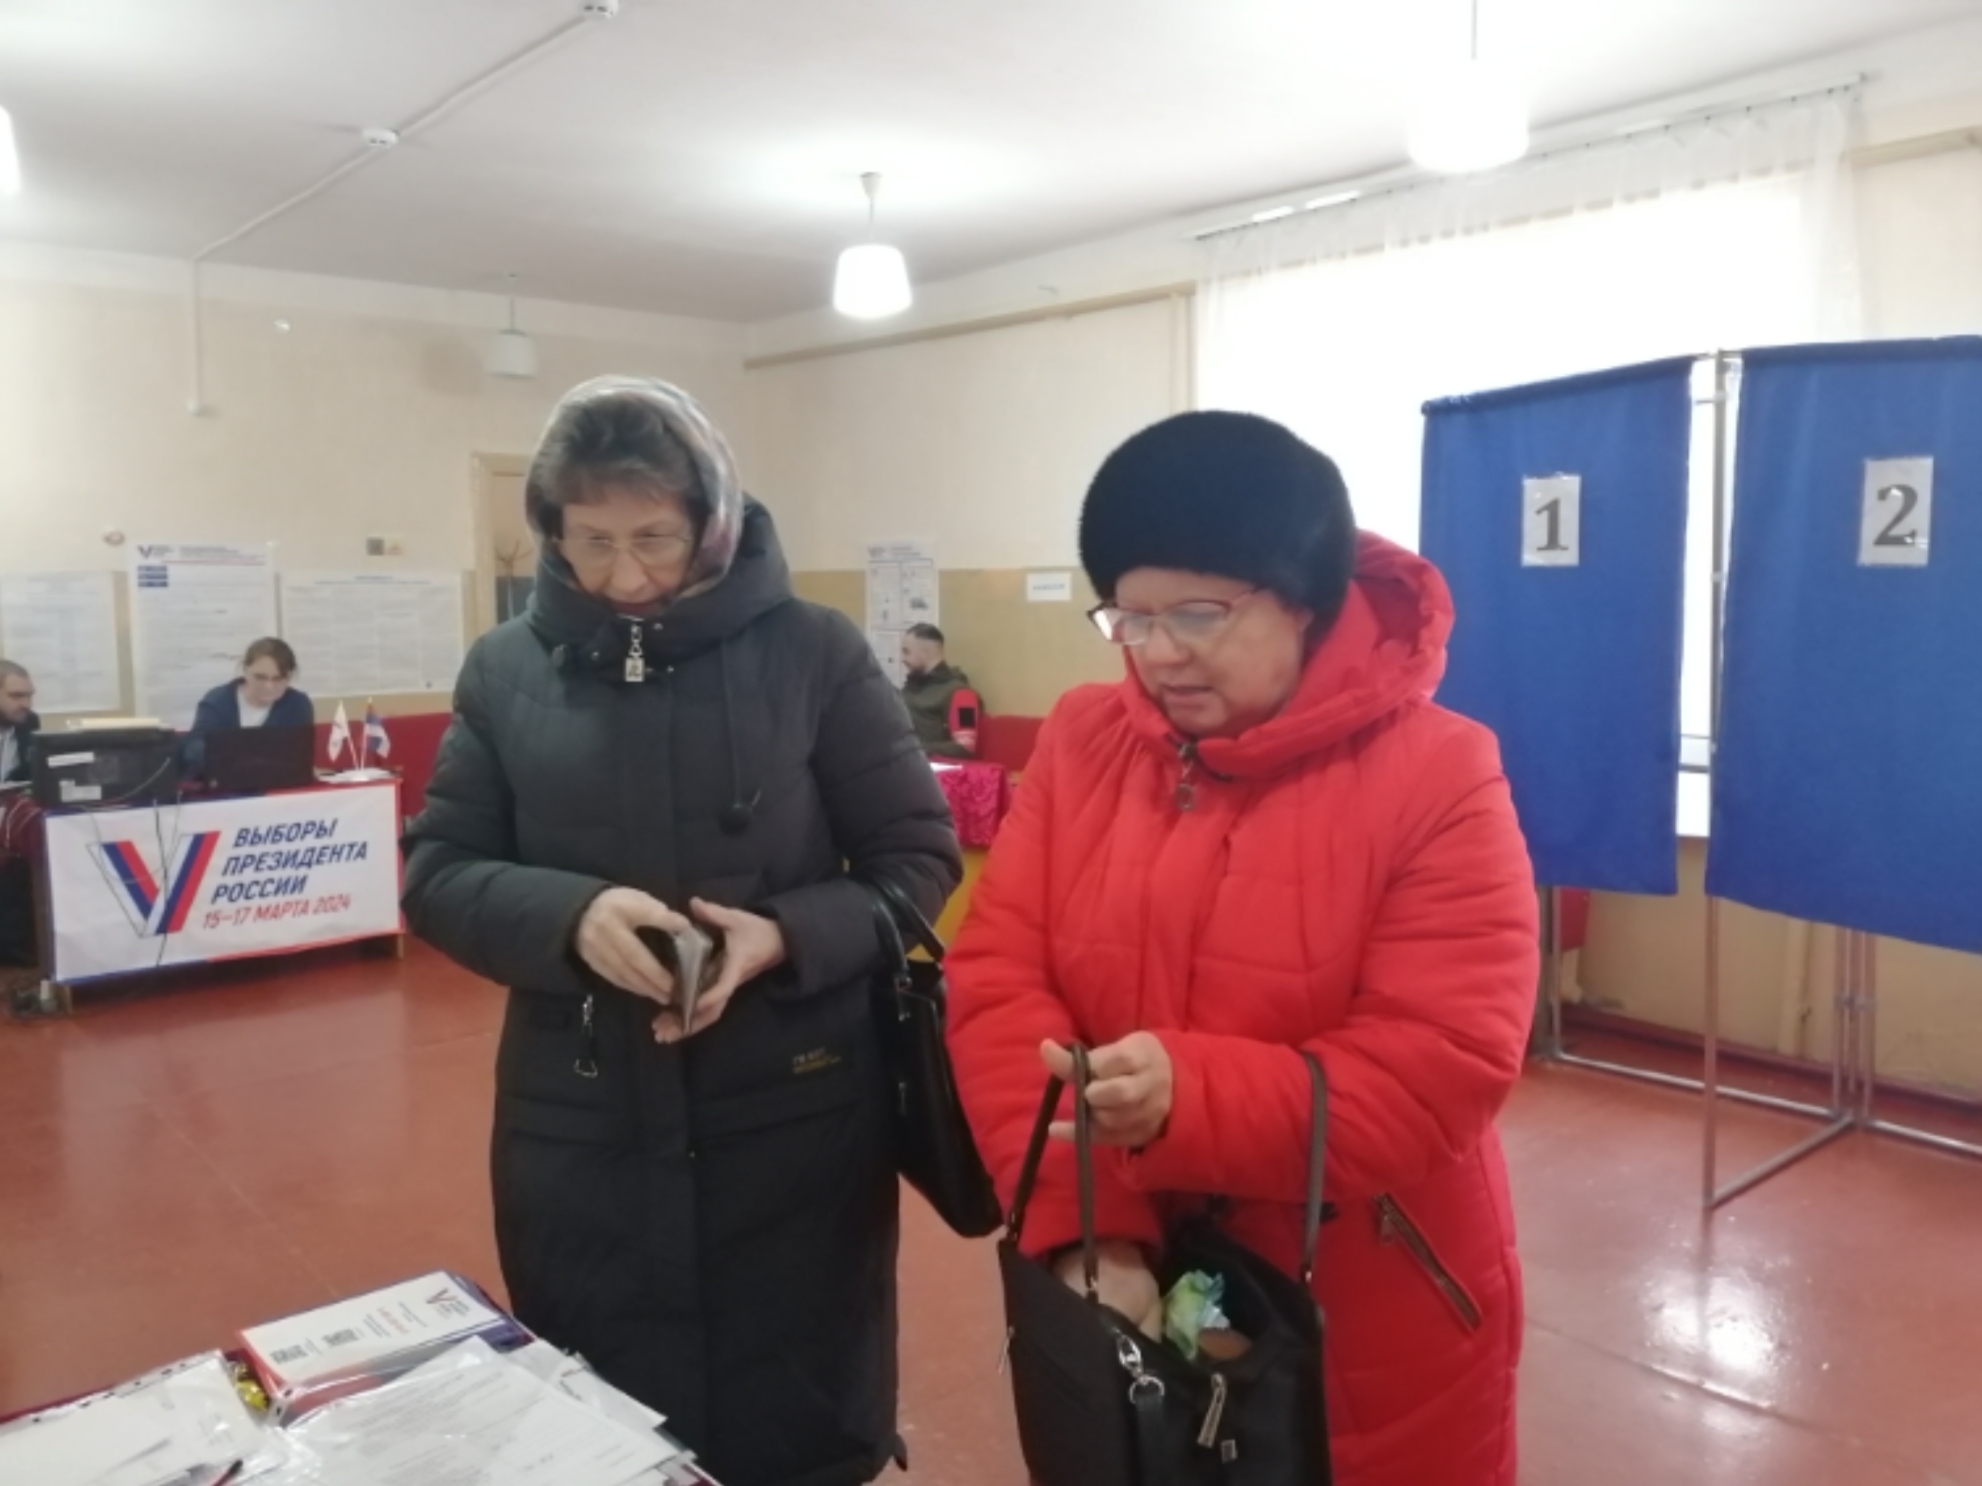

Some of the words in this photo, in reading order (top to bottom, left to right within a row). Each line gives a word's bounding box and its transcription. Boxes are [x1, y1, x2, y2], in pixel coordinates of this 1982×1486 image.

[1535, 497, 1569, 551] 1
[1873, 484, 1918, 547] 2
[233, 818, 338, 848] ВЫБОРЫ
[221, 841, 367, 876] ПРЕЗИДЕНТА
[211, 874, 308, 905] РОССИИ
[253, 899, 309, 923] МАРТА
[313, 893, 351, 915] 2024
